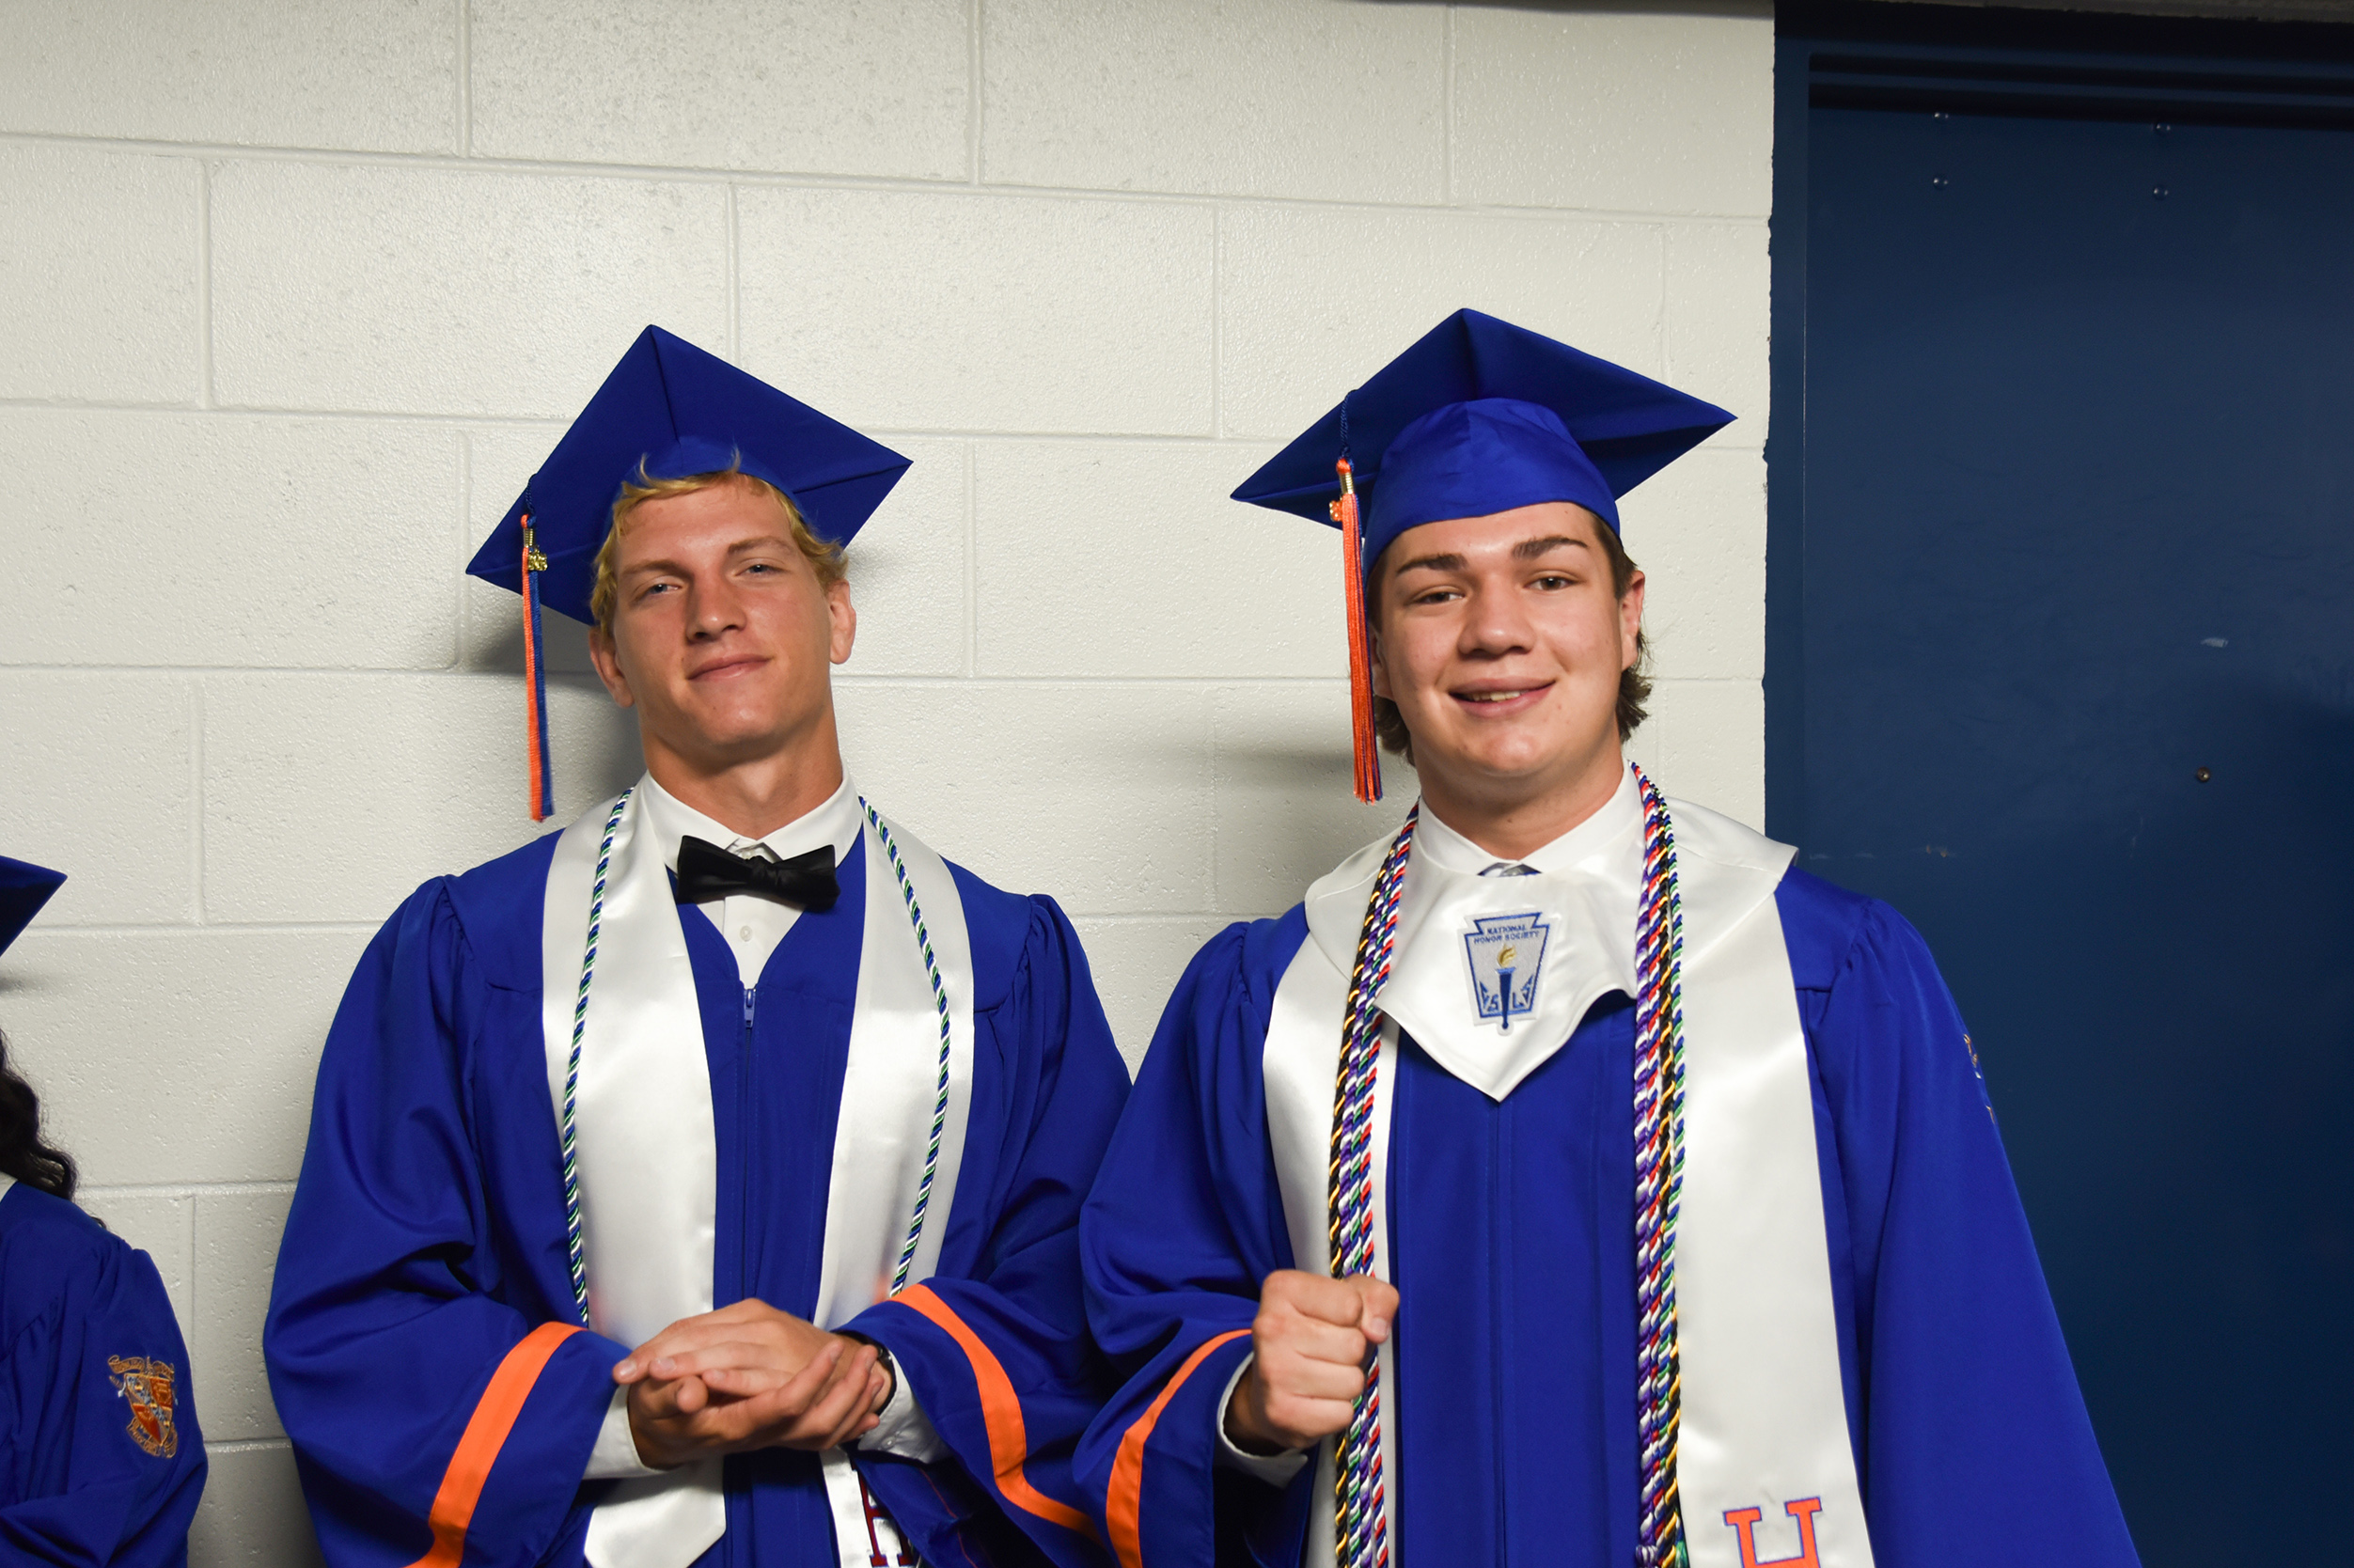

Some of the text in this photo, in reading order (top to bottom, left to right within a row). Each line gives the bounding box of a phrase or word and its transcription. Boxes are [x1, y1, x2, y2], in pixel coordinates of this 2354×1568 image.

[1487, 924, 1526, 934] NATIONAL
[1473, 930, 1540, 945] HONOR SOCIETY
